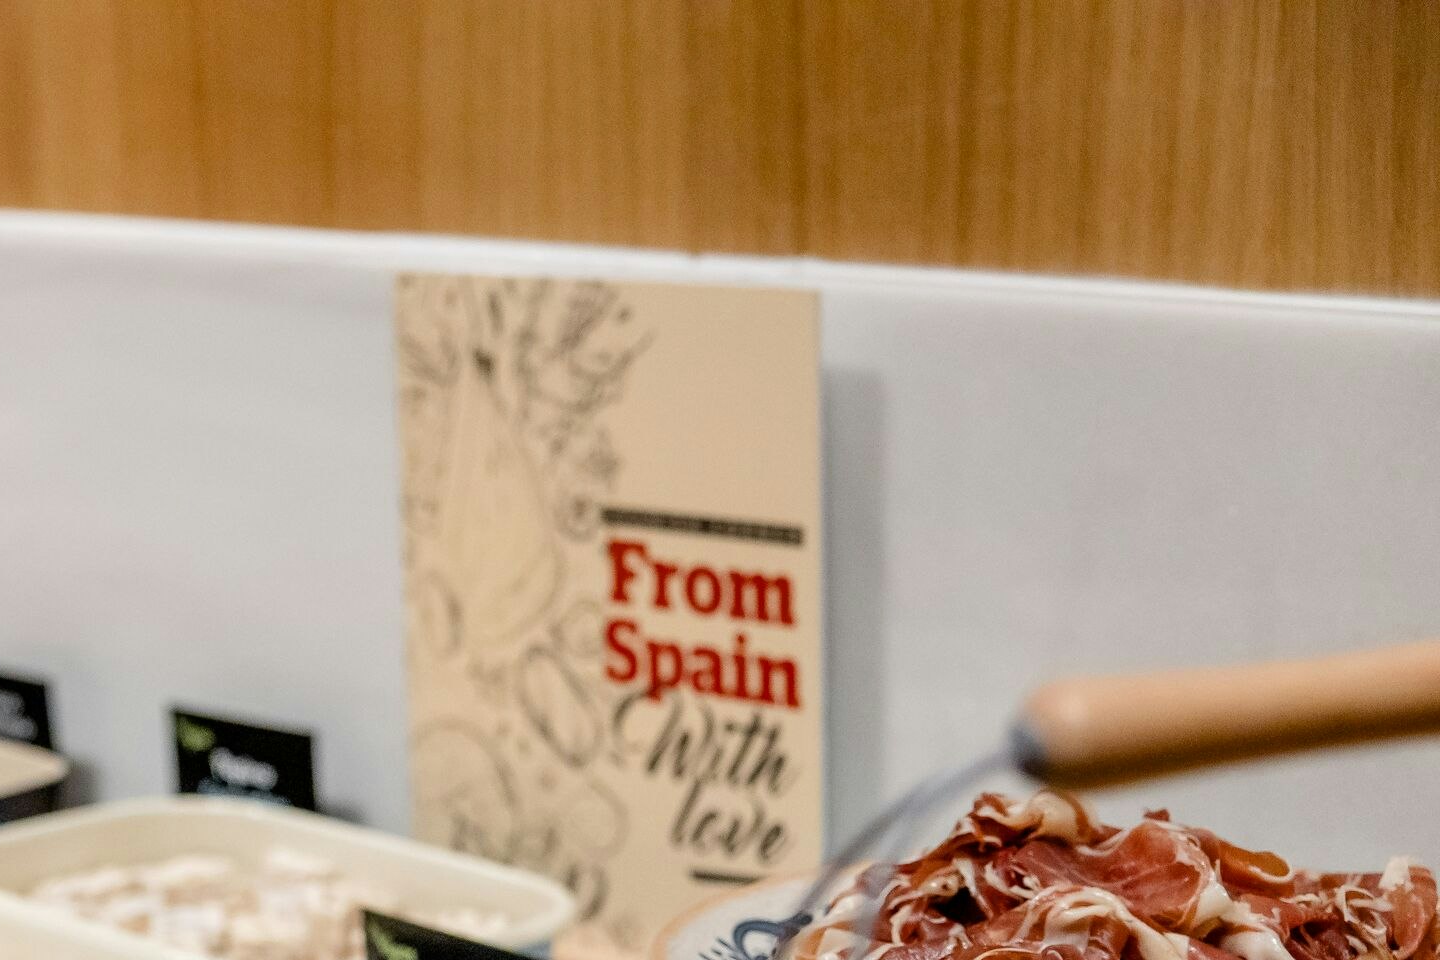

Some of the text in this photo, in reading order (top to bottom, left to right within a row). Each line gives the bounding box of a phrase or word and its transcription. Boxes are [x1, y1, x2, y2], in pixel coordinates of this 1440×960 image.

[607, 540, 796, 626] From
[605, 619, 800, 708] Spain
[612, 692, 798, 791] With
[670, 779, 790, 863] love
